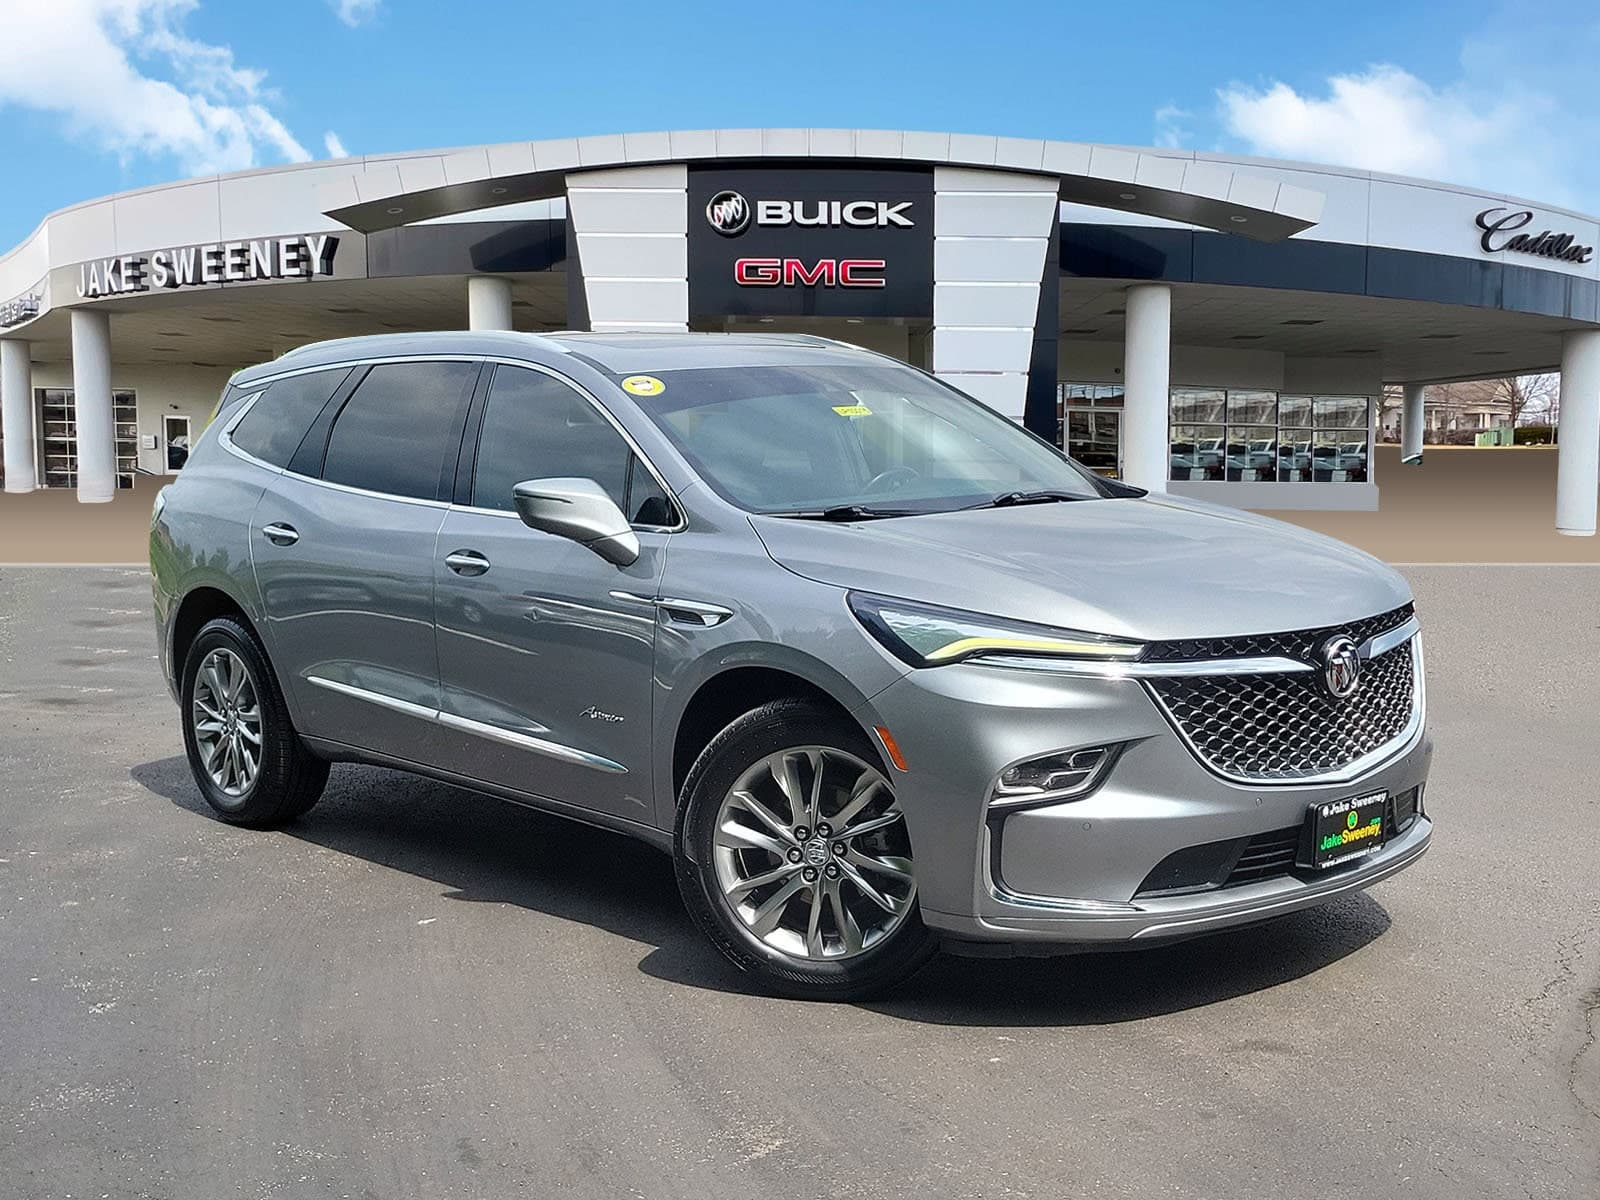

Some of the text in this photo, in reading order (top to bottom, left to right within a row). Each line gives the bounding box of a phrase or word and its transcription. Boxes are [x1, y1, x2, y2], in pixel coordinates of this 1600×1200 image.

[757, 200, 915, 227] BUICK
[1475, 207, 1593, 263] Cadillac
[76, 234, 335, 298] JAKE SWEENEY
[735, 257, 886, 287] GMC
